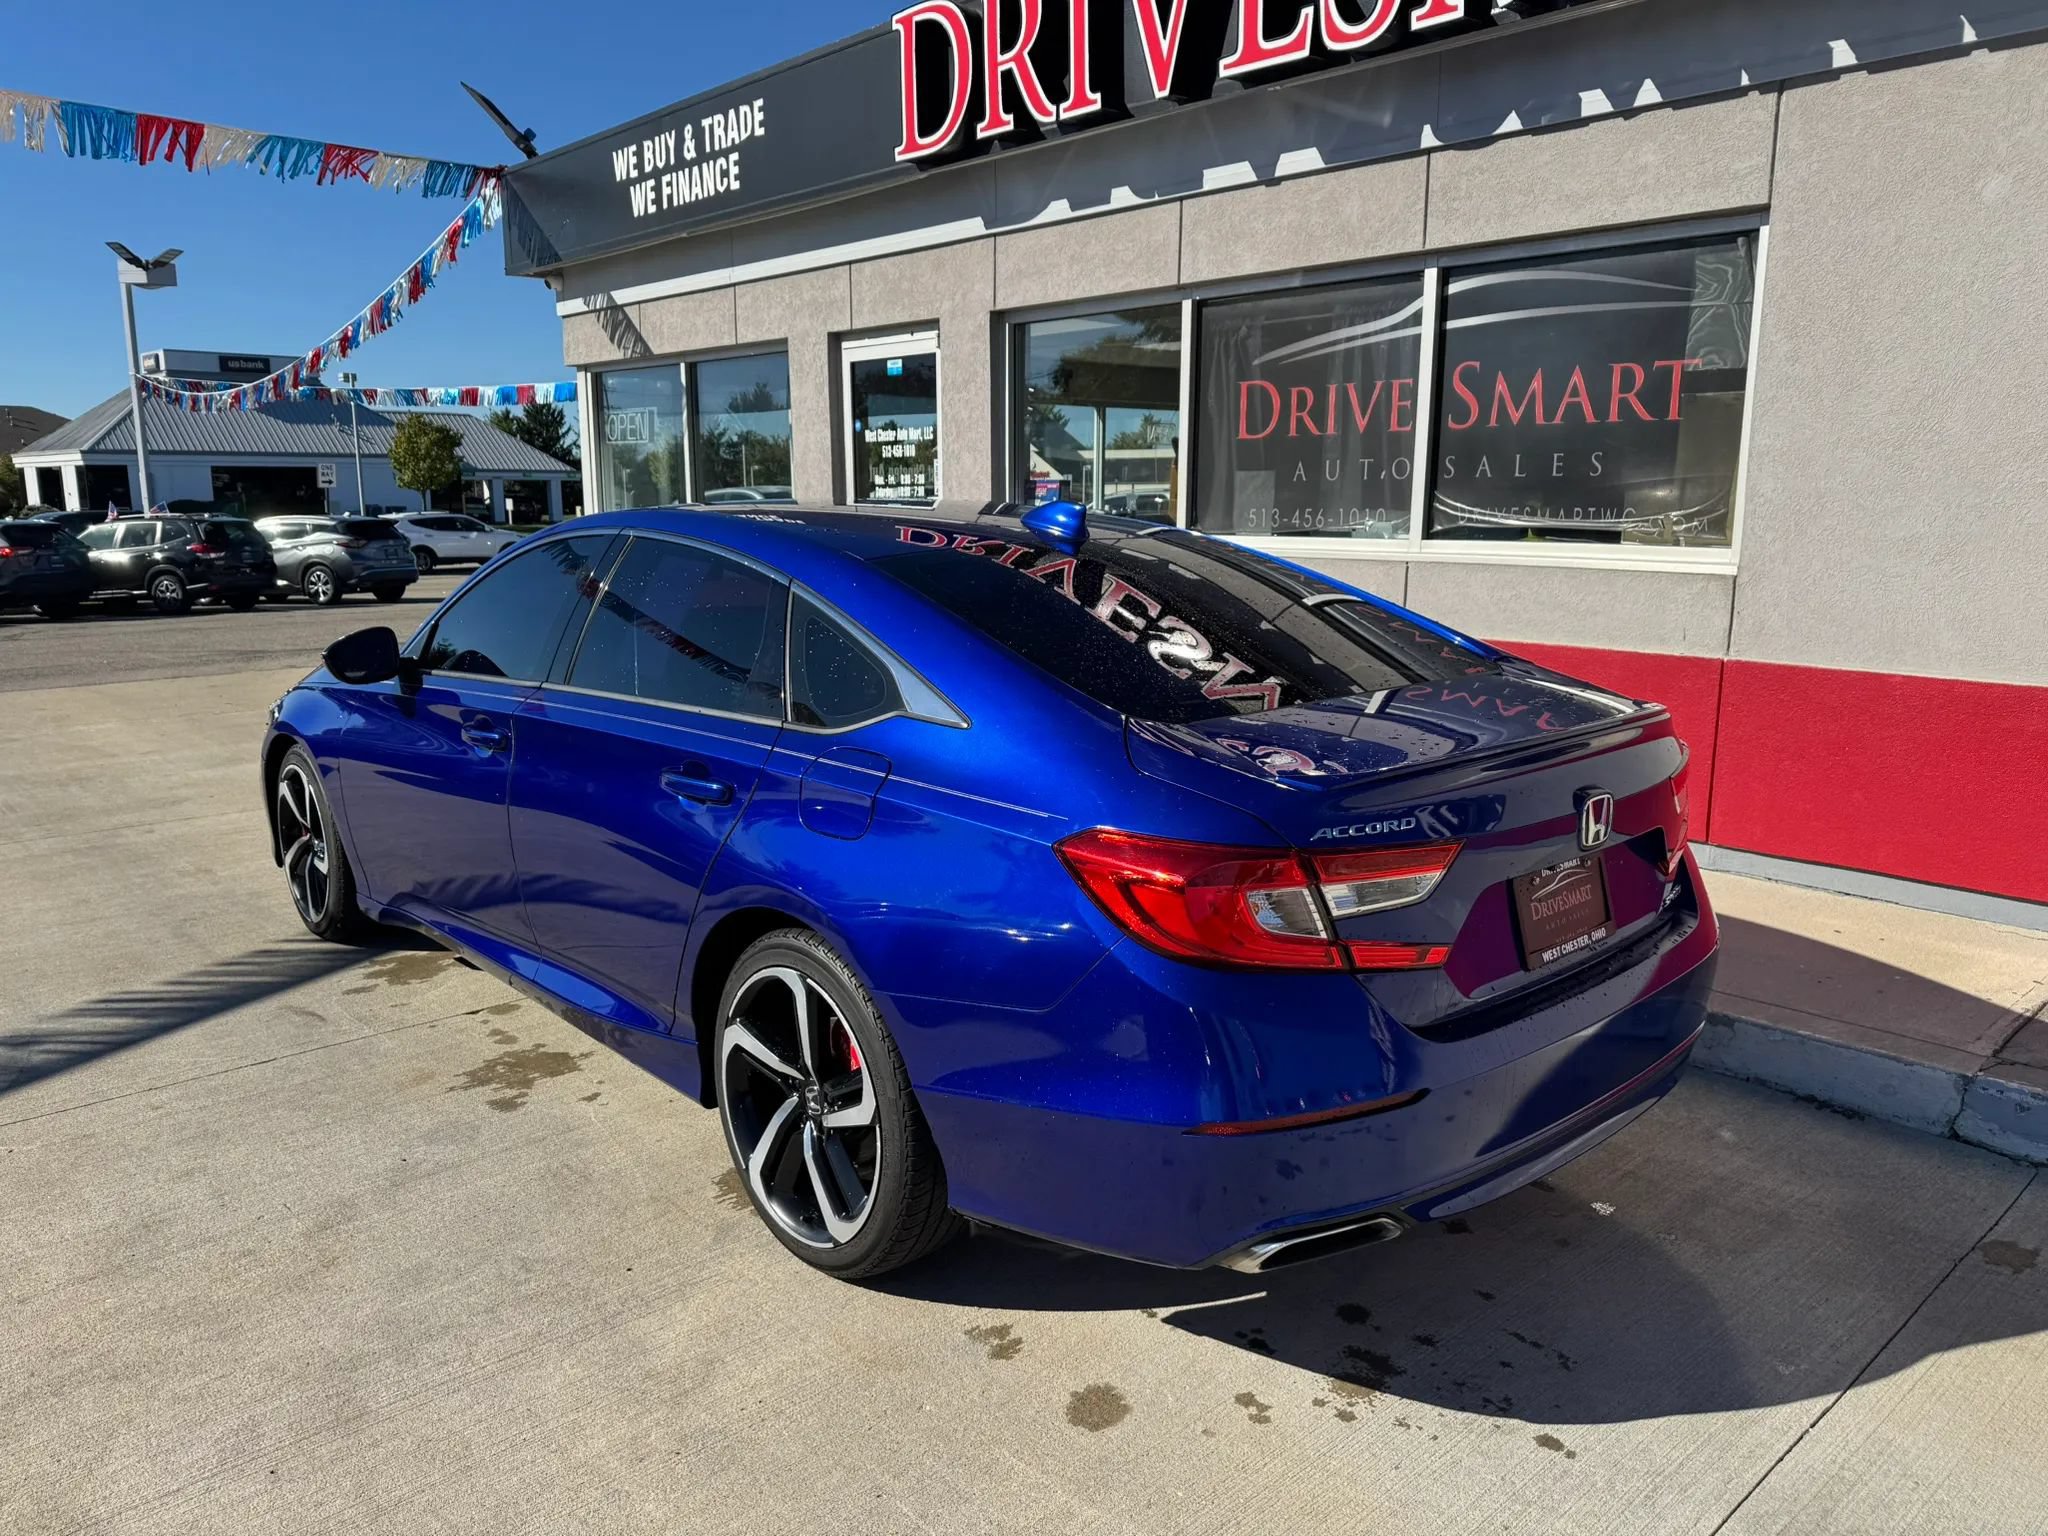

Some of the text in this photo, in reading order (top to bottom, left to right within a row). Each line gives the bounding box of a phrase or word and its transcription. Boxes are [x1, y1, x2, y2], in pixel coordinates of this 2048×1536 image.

[612, 98, 765, 182] WE BUY & TRADE
[629, 152, 741, 218] WE FINANCE
[1236, 359, 1704, 440] DRIVE SMART
[607, 413, 648, 441] OPEN
[923, 425, 934, 440] LLC
[1292, 452, 1603, 482] AUTO SALES
[1248, 508, 1386, 528] 513-456-1010
[1309, 817, 1416, 841] ACCORD
[1530, 884, 1592, 921] DRIVESMART
[1541, 948, 1561, 963] WEST
[1561, 934, 1592, 955] CHESTER,
[1591, 926, 1607, 942] OHIO
